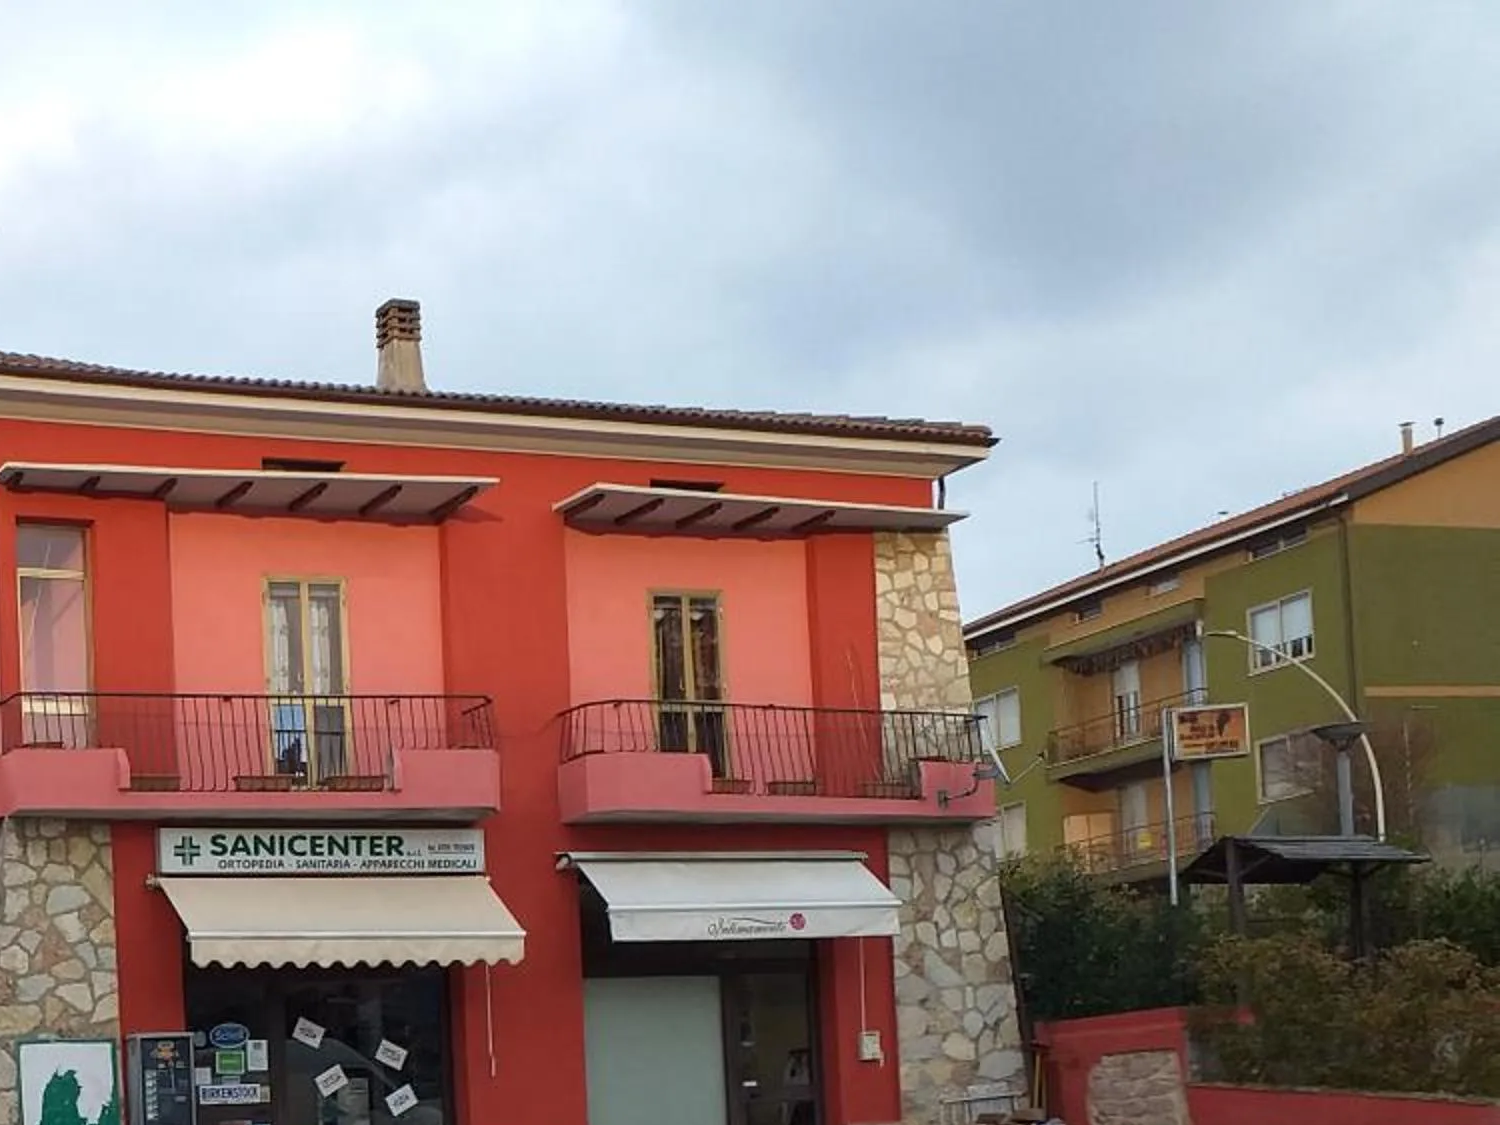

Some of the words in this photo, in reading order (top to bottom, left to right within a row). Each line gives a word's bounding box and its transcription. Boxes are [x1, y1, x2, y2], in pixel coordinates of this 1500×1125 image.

[210, 834, 404, 857] SANICENTER
[218, 859, 284, 869] ORTOPEDIA
[296, 859, 350, 869] SANITARIA
[360, 859, 425, 869] APPARECCHI
[428, 859, 477, 869] MEDICALI
